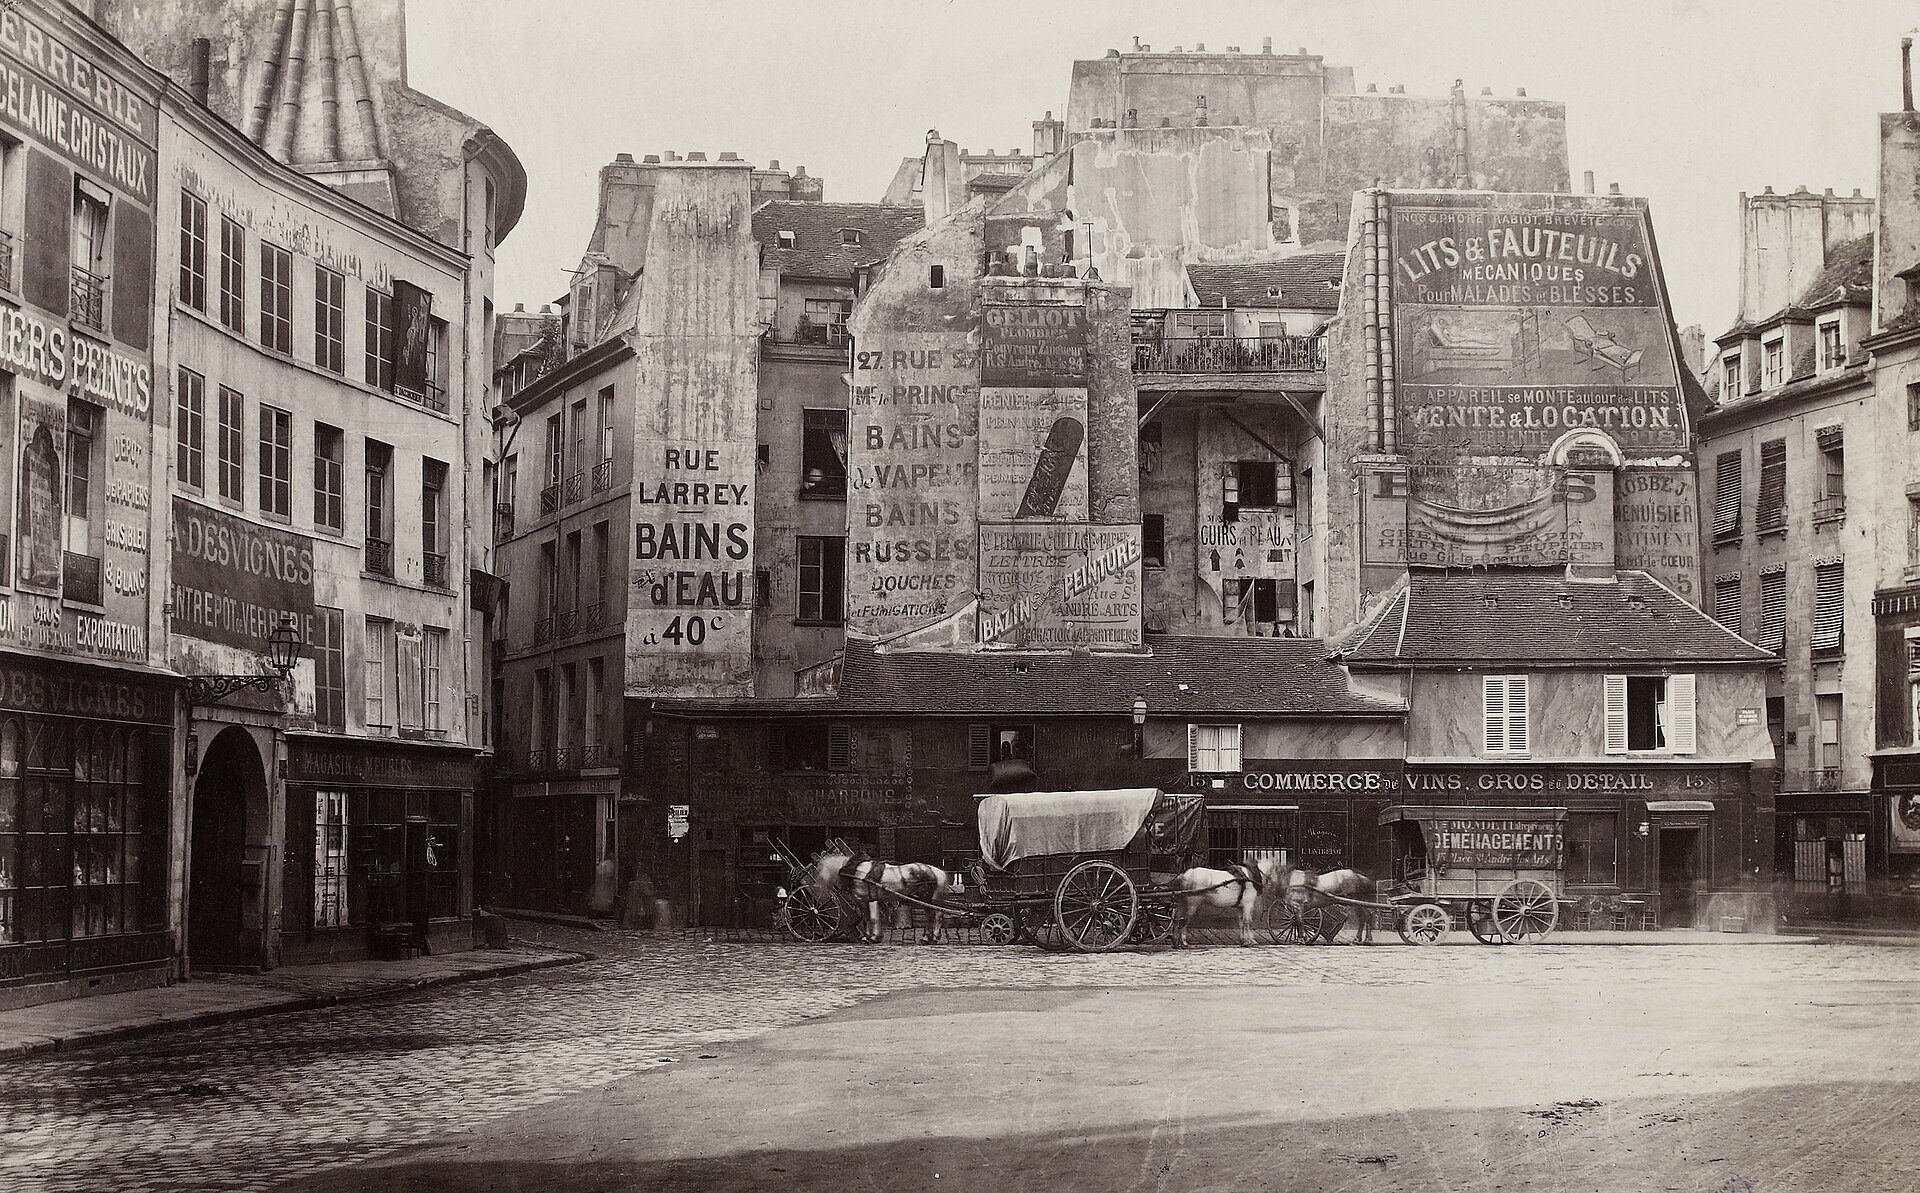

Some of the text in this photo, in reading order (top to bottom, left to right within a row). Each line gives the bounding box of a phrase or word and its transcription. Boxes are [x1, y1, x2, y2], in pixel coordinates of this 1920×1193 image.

[71, 109, 148, 197] CRISTAUX
[1398, 227, 1642, 282] LITS & FAUTEUILS
[1463, 263, 1584, 285] MÉCANIQUES
[1450, 284, 1531, 302] MALADES
[893, 350, 941, 369] RUE
[71, 336, 150, 413] PEINTS
[1427, 389, 1505, 403] APPAREIL
[1523, 389, 1576, 404] MONTE
[1509, 412, 1522, 428] &
[866, 424, 964, 451] BAINS
[665, 449, 720, 471] RUE
[866, 501, 961, 528] BAINS
[635, 523, 750, 560] BAINS
[1200, 525, 1237, 546] CUIRS
[187, 515, 314, 586] DESVIGNES
[871, 574, 957, 593] DOUCHES
[1677, 573, 1693, 595] 5
[77, 615, 145, 657] EXPORTATION
[1243, 773, 1381, 791] COMMERCE
[1477, 773, 1545, 791] GROS
[1565, 773, 1654, 791] DETAIL
